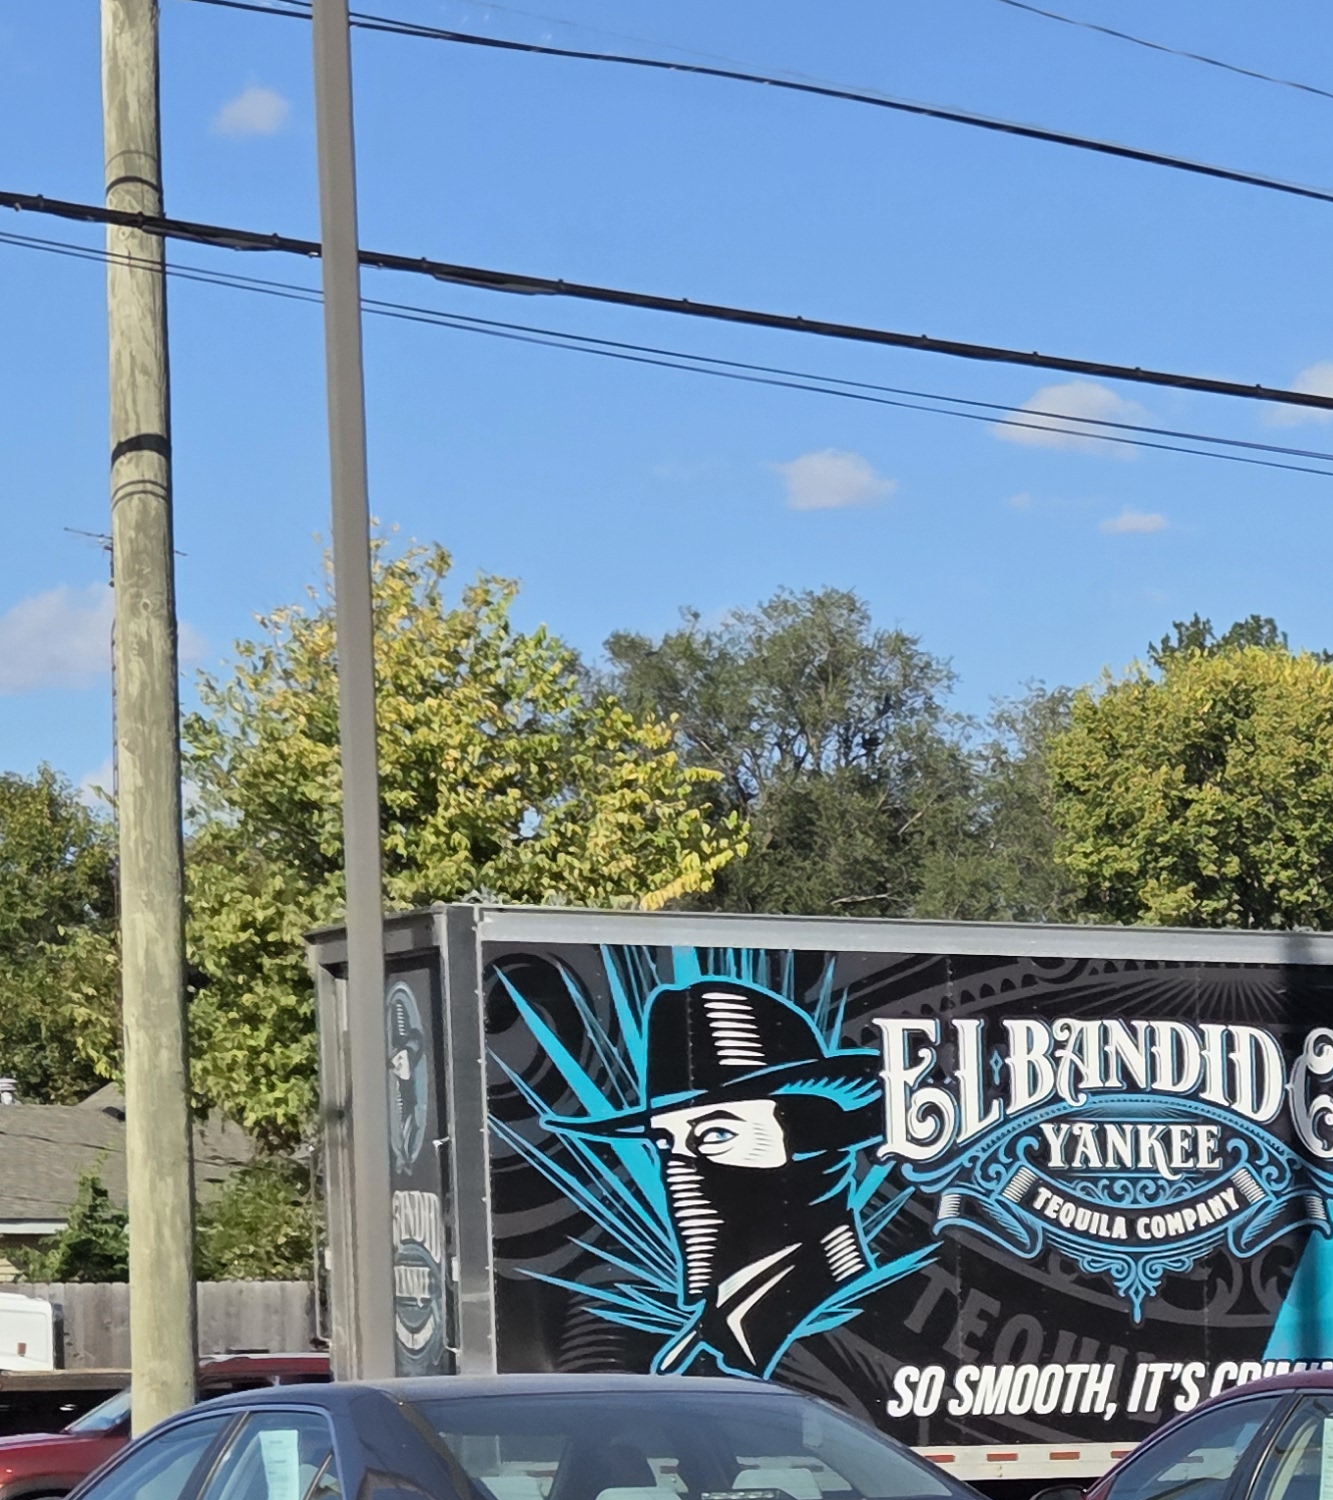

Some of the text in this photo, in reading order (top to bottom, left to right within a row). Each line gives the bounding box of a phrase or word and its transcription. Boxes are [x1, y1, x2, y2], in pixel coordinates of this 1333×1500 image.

[872, 1016, 1006, 1161] EL
[1040, 1122, 1224, 1181] YANKEE
[1031, 1186, 1242, 1241] TEQUILA COMPANY
[887, 1364, 946, 1418] SO
[948, 1362, 1118, 1421] SMOOTH,
[1126, 1361, 1206, 1413] IT'S
